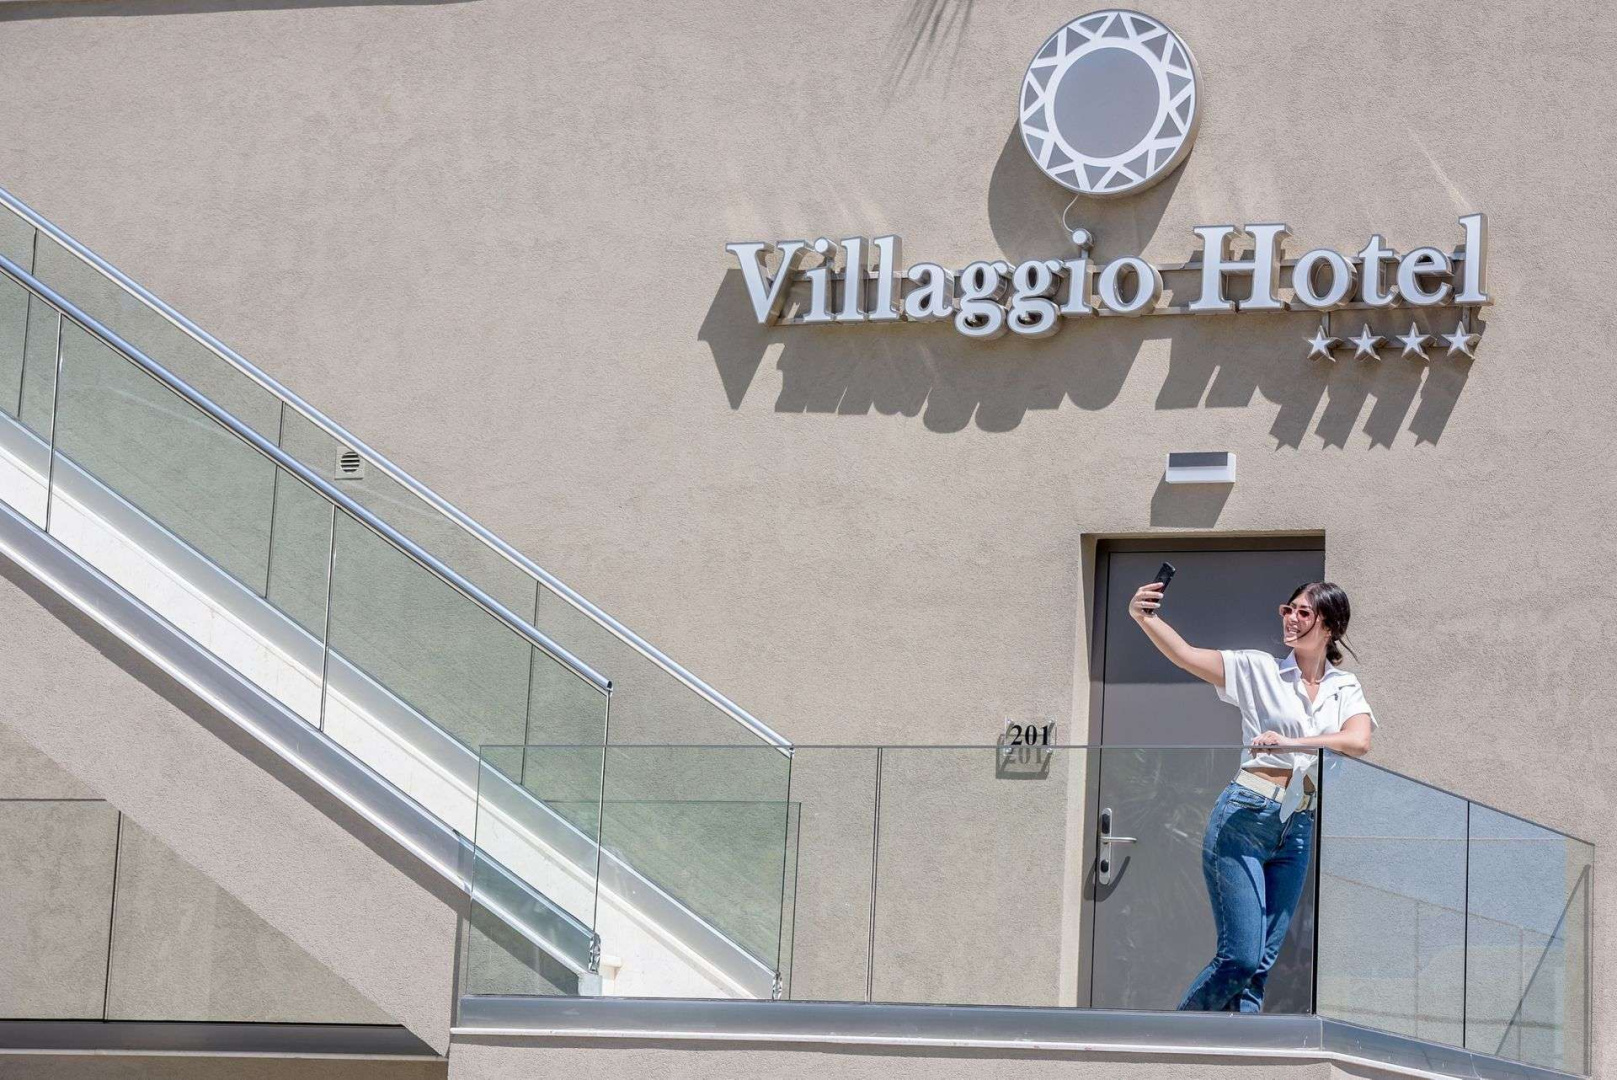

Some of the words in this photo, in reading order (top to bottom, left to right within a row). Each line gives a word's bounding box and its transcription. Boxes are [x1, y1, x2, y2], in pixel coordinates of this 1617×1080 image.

[726, 229, 1162, 339] Villaggio
[1188, 213, 1492, 311] Hotel
[1010, 724, 1049, 746] 201
